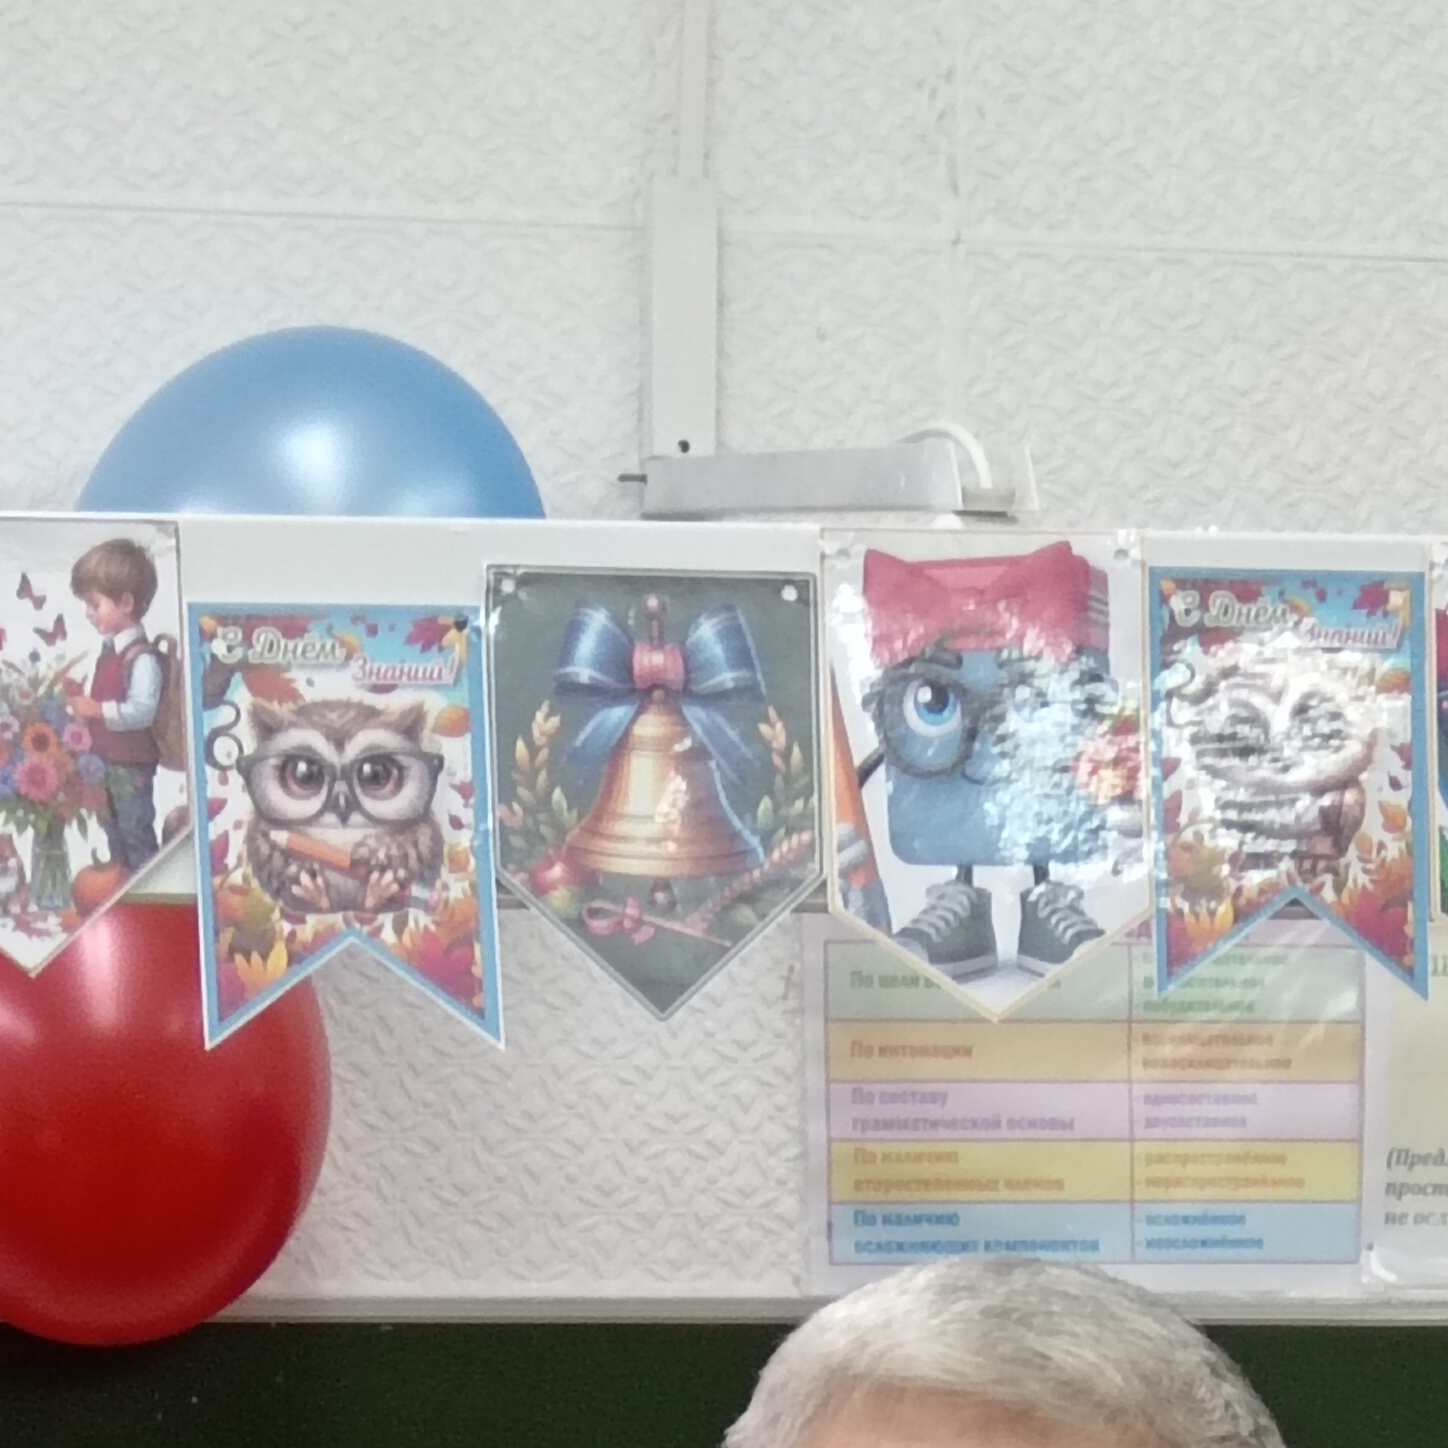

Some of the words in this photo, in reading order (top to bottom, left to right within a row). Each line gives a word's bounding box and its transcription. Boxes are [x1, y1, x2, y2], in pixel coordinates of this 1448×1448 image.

[213, 627, 242, 663] С
[248, 627, 345, 664] Днём
[352, 653, 459, 684] Знаний!
[850, 971, 874, 989] По
[850, 1041, 874, 1059] По
[851, 1088, 875, 1106] По
[854, 1147, 878, 1165] По
[854, 1210, 878, 1227] По
